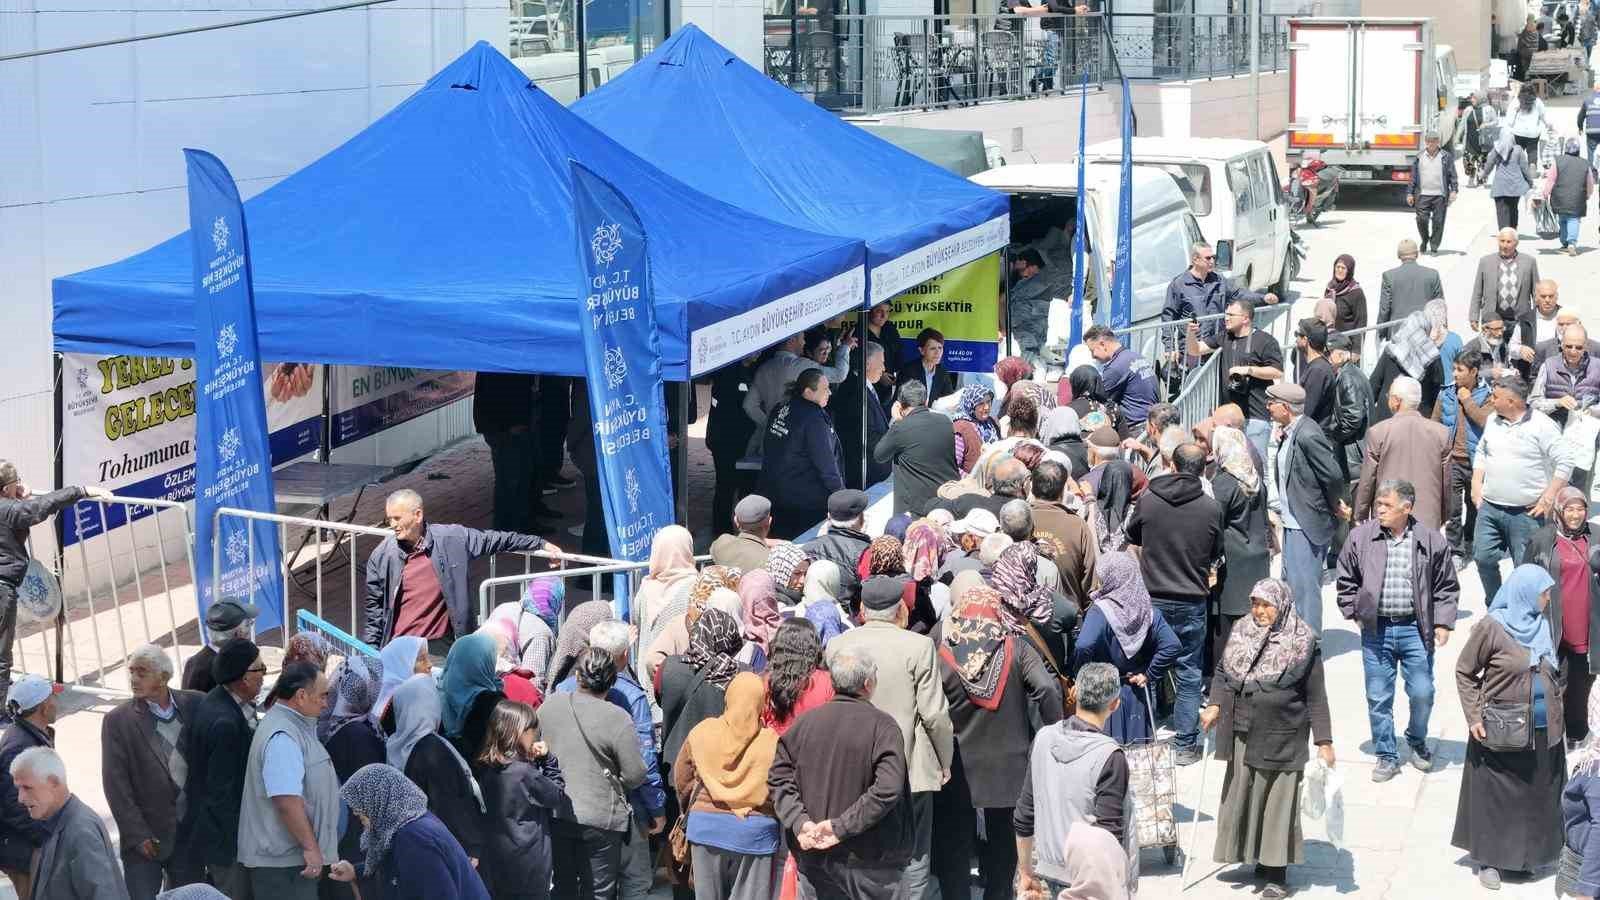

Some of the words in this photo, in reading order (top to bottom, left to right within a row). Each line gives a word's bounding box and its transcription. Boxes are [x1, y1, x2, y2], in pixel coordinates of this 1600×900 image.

[761, 302, 804, 334] BÜYÜKŞEHİR
[906, 300, 973, 313] YÜKSEKTİR
[97, 354, 175, 394] YEREL
[352, 374, 370, 398] EN
[104, 380, 197, 441] GELECE
[98, 440, 190, 482] Tohumuna
[164, 467, 196, 489] ÖZLEM
